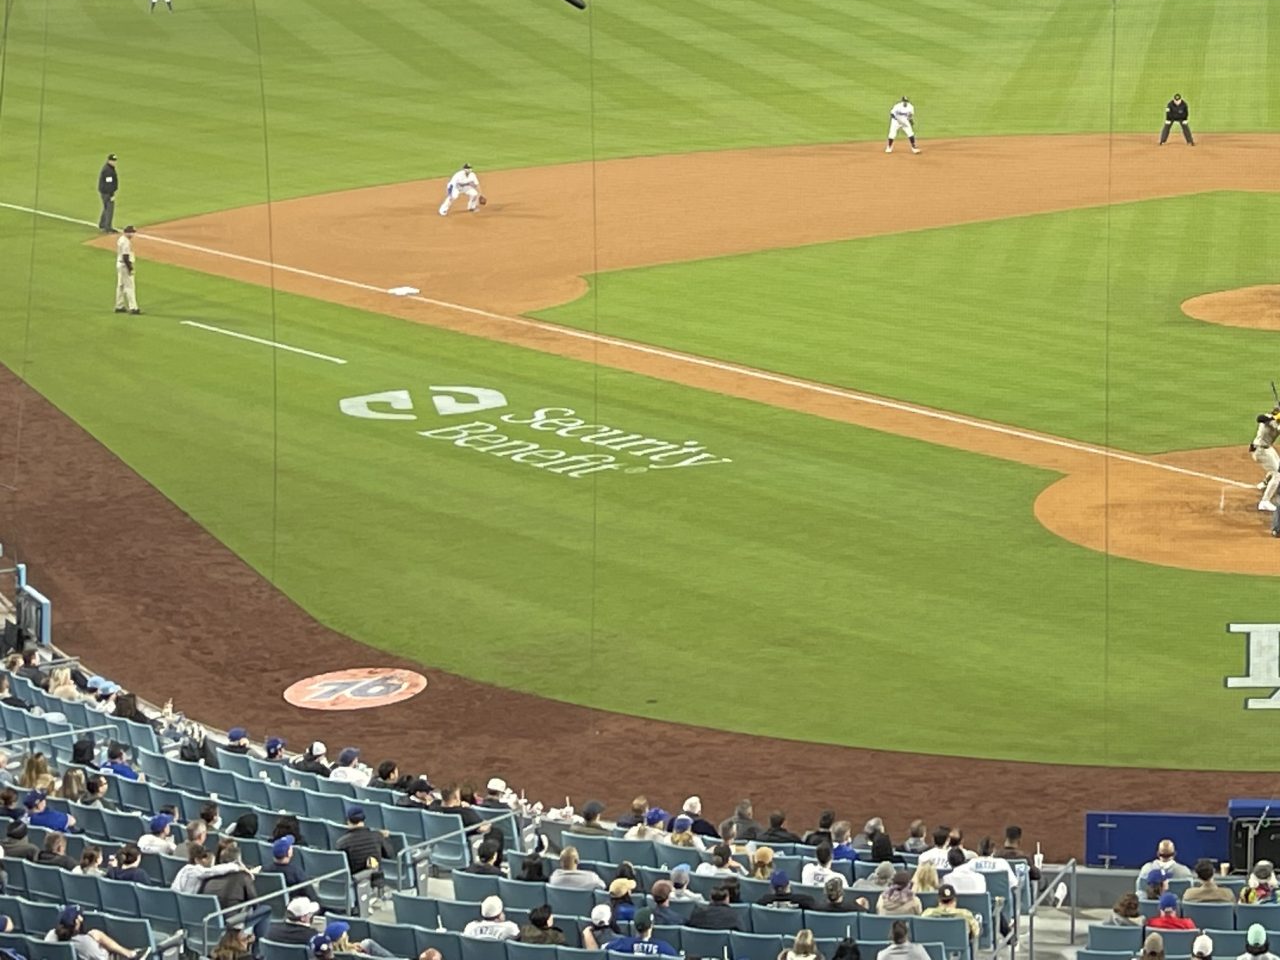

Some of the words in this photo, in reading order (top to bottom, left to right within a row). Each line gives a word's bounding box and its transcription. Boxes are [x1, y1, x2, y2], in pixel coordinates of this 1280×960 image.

[416, 421, 621, 478] Benefit
[501, 407, 732, 469] Security
[307, 674, 407, 701] 76
